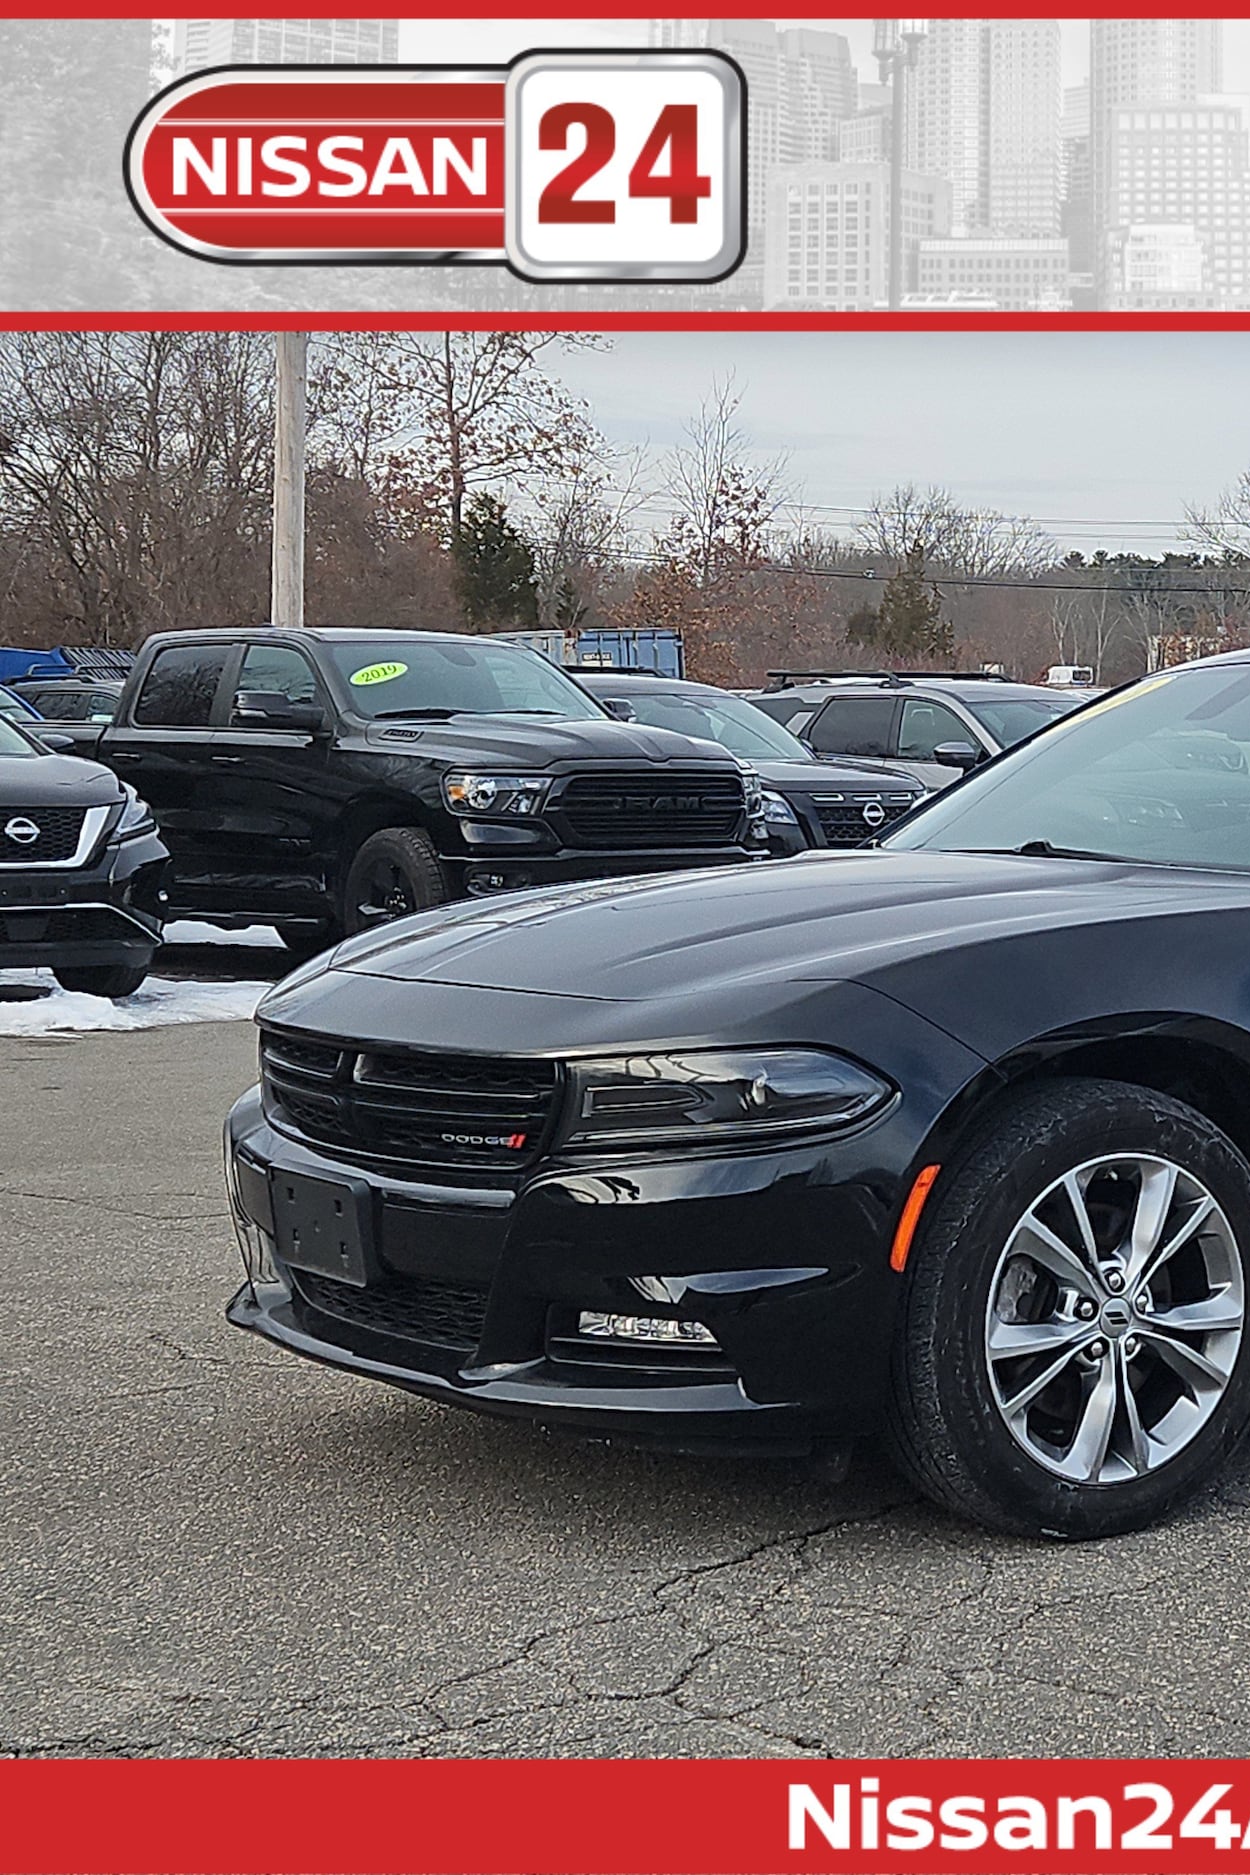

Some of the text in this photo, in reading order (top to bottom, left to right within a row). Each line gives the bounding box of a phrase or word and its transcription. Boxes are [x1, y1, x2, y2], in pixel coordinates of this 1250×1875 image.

[362, 665, 397, 682] 2019
[624, 796, 700, 810] RAM
[441, 1133, 514, 1146] DODGE
